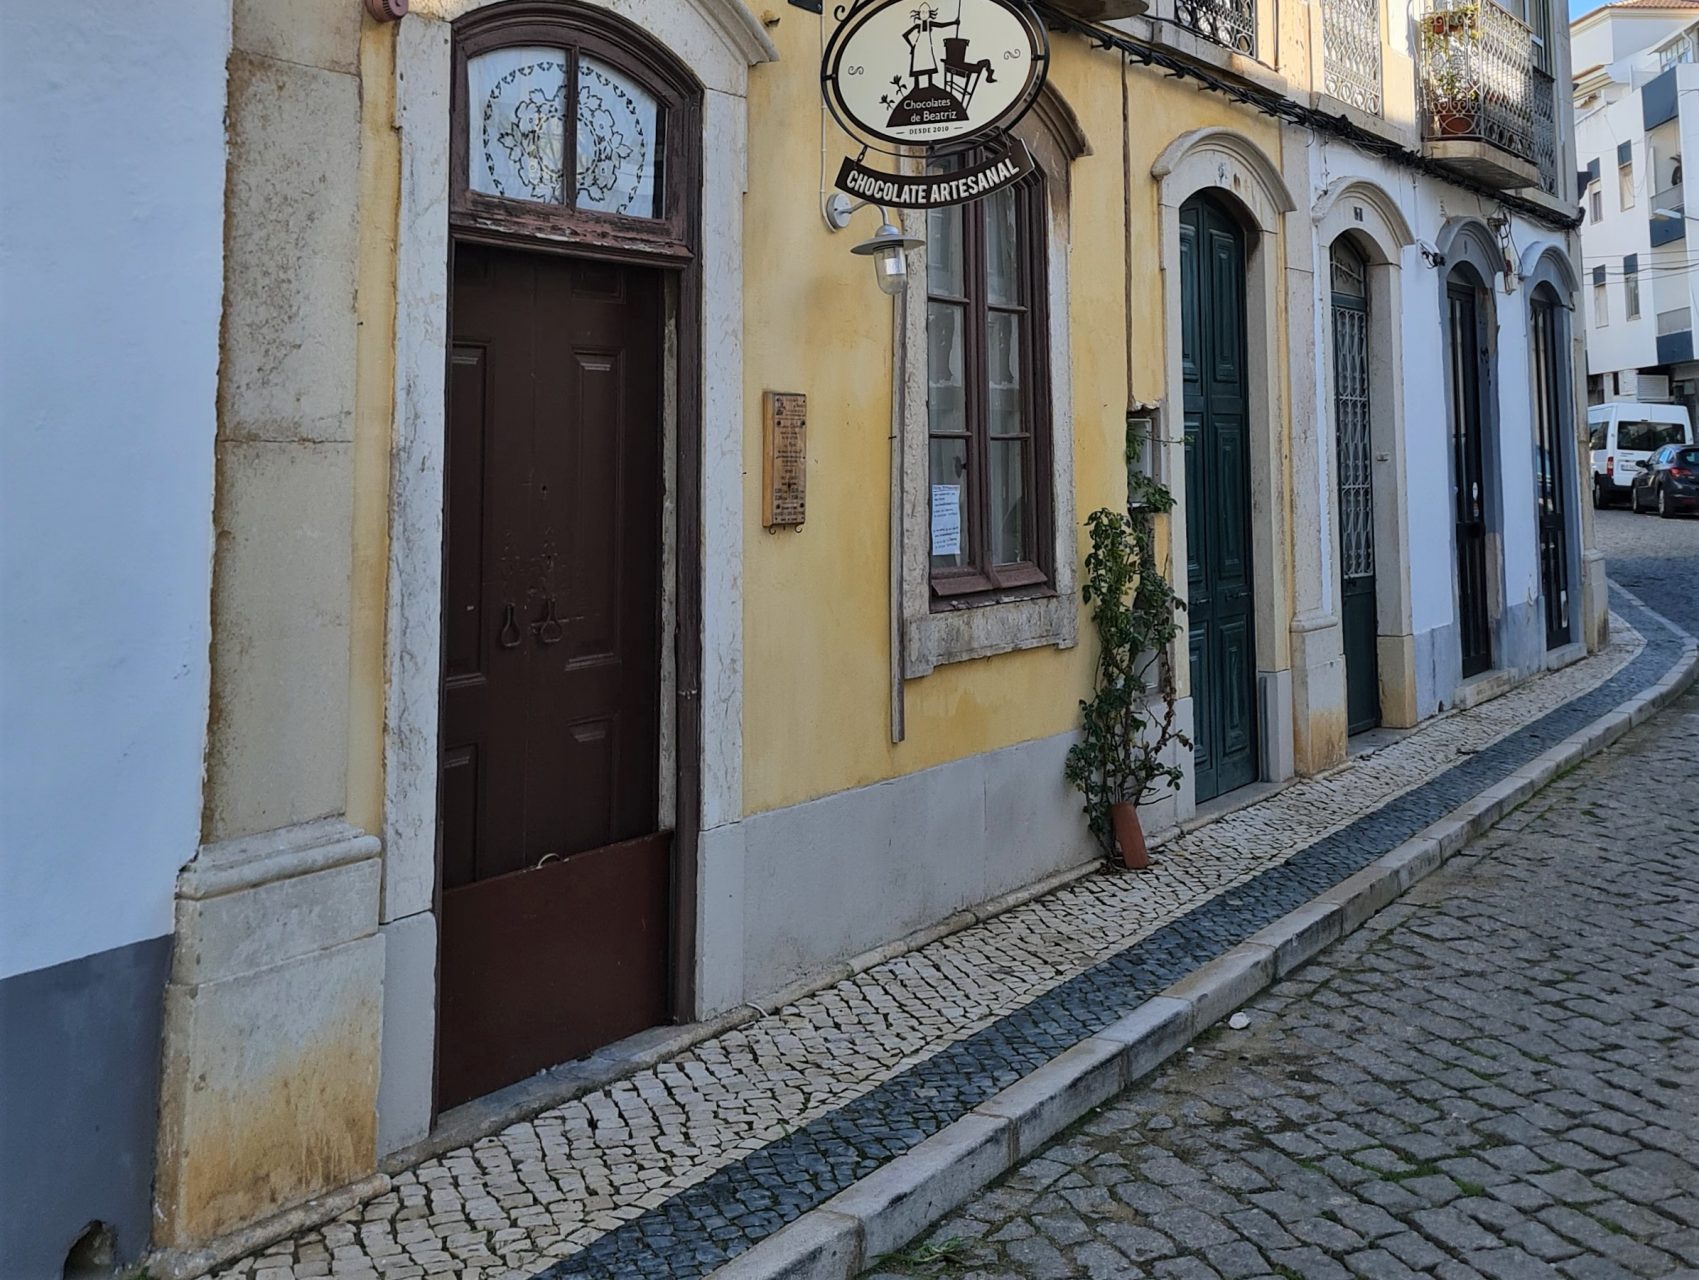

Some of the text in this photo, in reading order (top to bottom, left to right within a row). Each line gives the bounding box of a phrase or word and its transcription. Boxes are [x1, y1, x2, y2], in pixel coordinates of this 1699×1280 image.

[903, 97, 951, 110] Chocolates
[910, 110, 957, 123] de Beatriz
[909, 127, 931, 135] DESDE
[846, 158, 1020, 204] CHOCOLATE ARTESANAL
